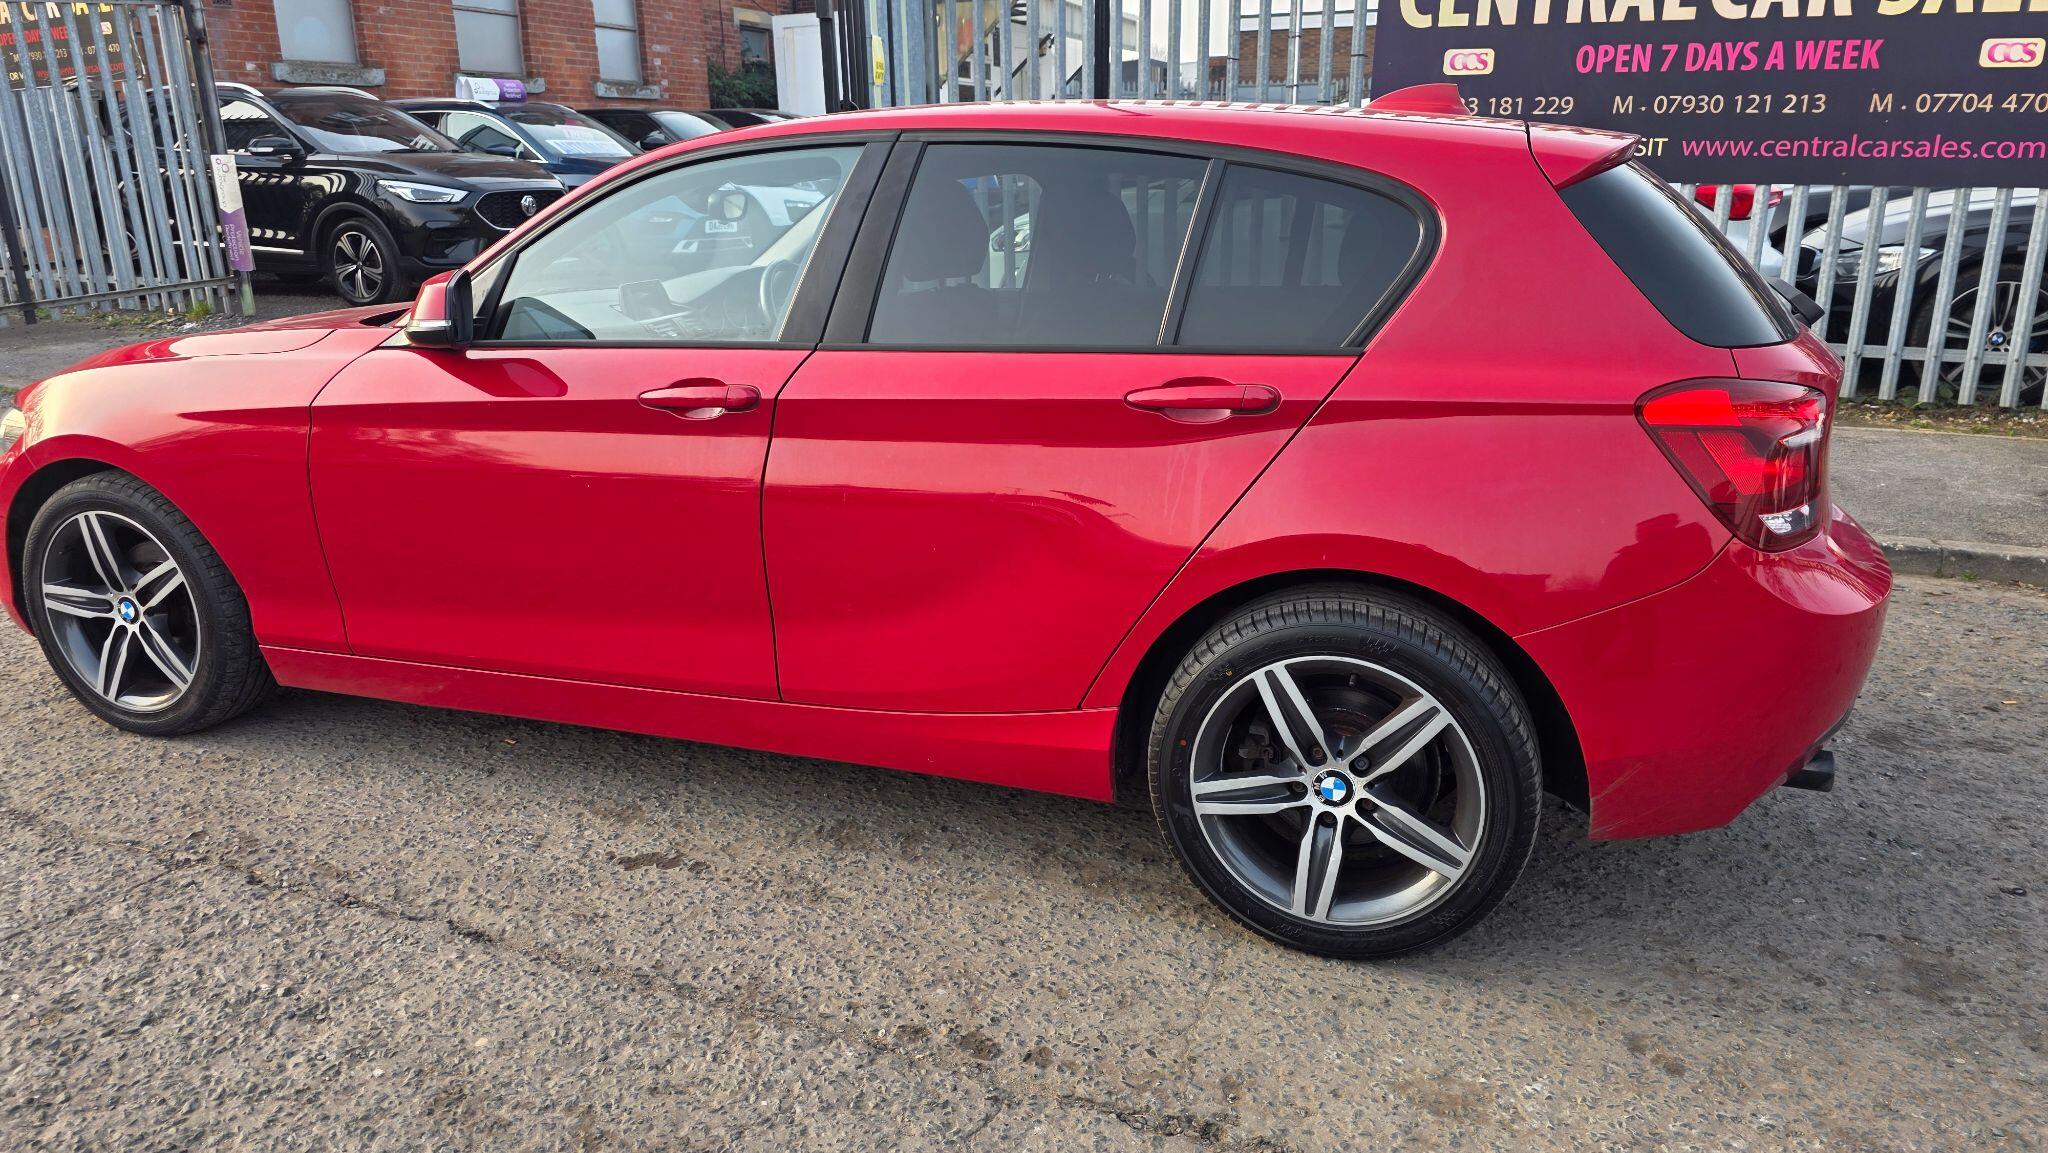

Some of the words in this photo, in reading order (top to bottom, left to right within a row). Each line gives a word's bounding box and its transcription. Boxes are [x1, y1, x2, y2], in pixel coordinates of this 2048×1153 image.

[1449, 52, 1489, 72] CCS
[1575, 44, 1653, 74] OPEN
[1660, 44, 1679, 73] 7
[1685, 41, 1759, 73] DAYS
[1763, 41, 1784, 71] A
[1795, 39, 1885, 71] WEEK
[1987, 42, 2039, 63] CCS
[1461, 97, 1479, 116] 3
[1488, 96, 1523, 115] 181
[1532, 96, 1575, 115] 229
[1612, 95, 1634, 115] M
[1653, 94, 1725, 115] 07930
[1735, 93, 1772, 114] 121
[1782, 93, 1827, 114] 213
[1869, 93, 1894, 113] M
[1915, 93, 1994, 113] 07704
[1633, 138, 1669, 157] SIT
[1682, 133, 2046, 160] www.centralcarsales.com
